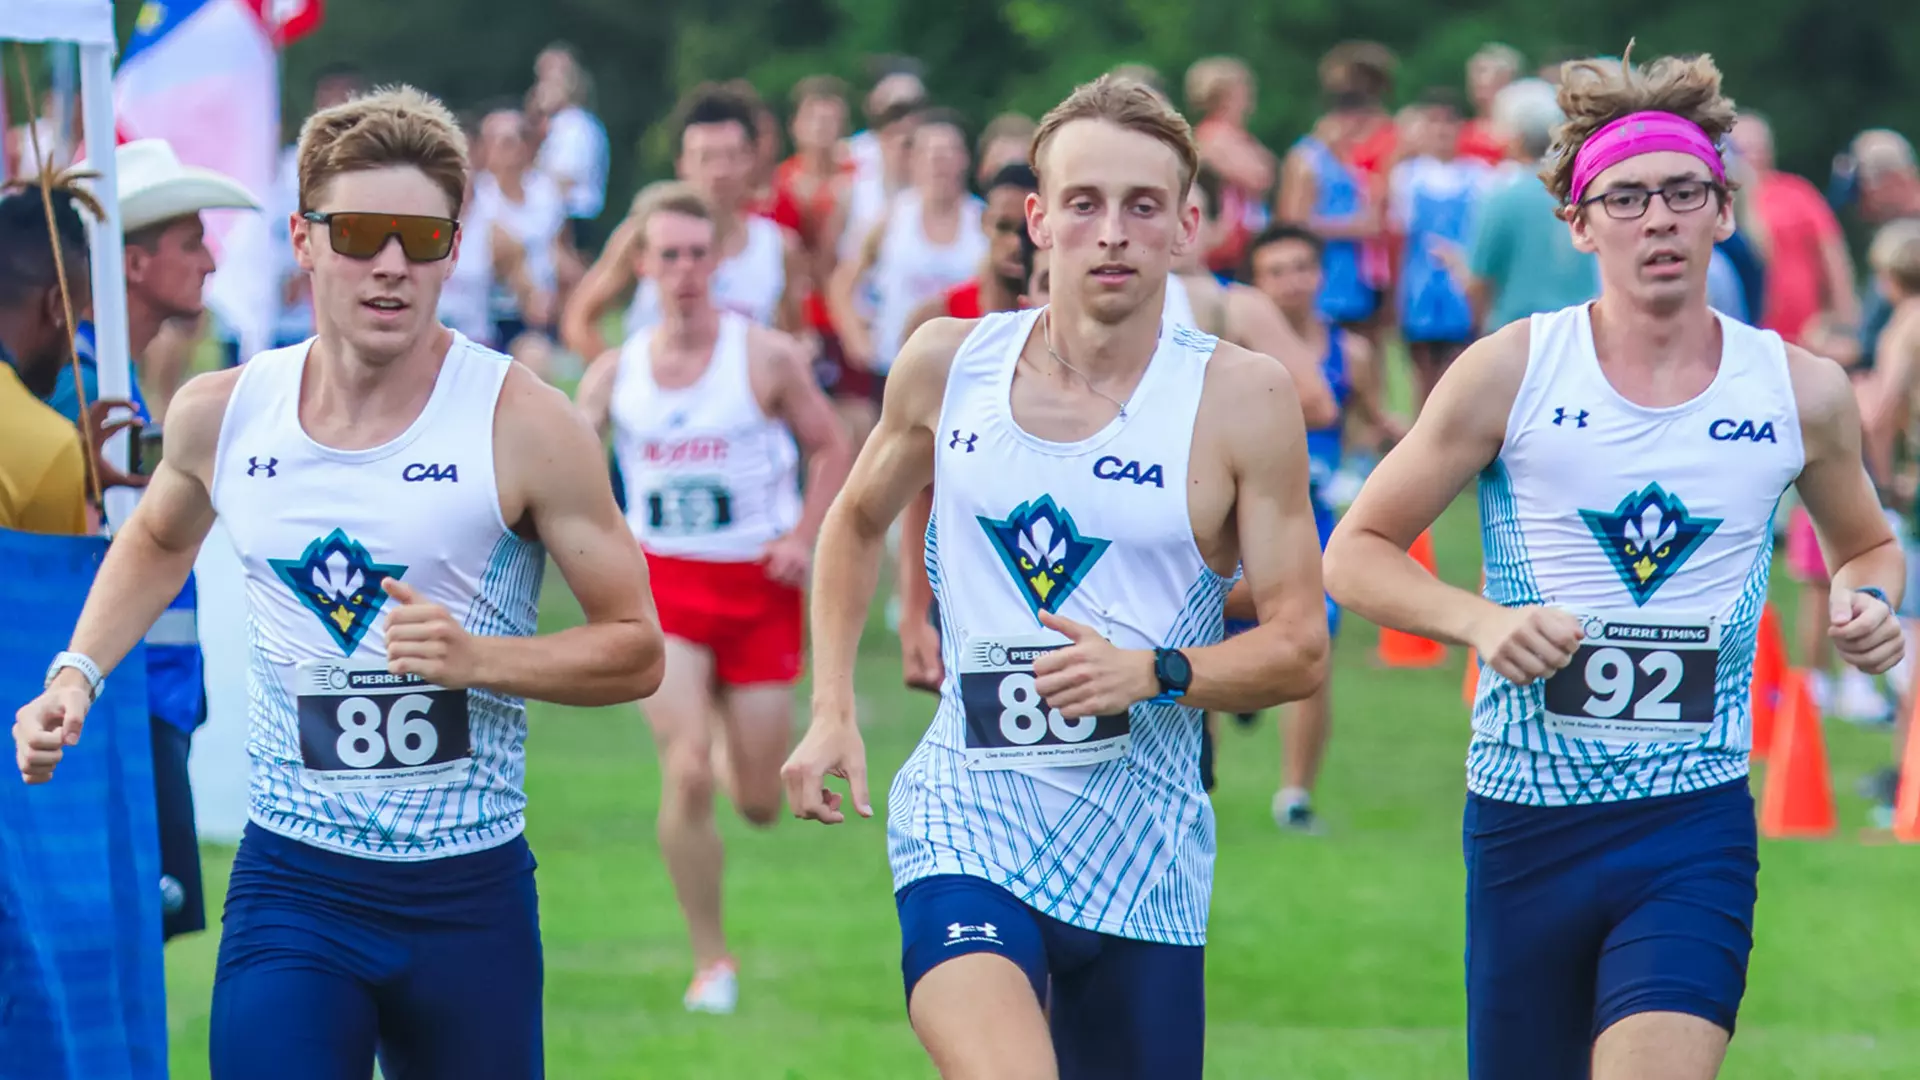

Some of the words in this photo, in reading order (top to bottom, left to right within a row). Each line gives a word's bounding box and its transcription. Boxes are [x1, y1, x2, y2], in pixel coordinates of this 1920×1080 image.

[1709, 419, 1777, 444] CAA
[402, 463, 458, 482] CAA
[1093, 455, 1165, 488] CAA
[1608, 626, 1658, 638] PIERRE
[1660, 628, 1706, 640] TIMING
[351, 674, 403, 685] PIERRE
[1582, 647, 1684, 720] 92
[336, 694, 438, 768] 86
